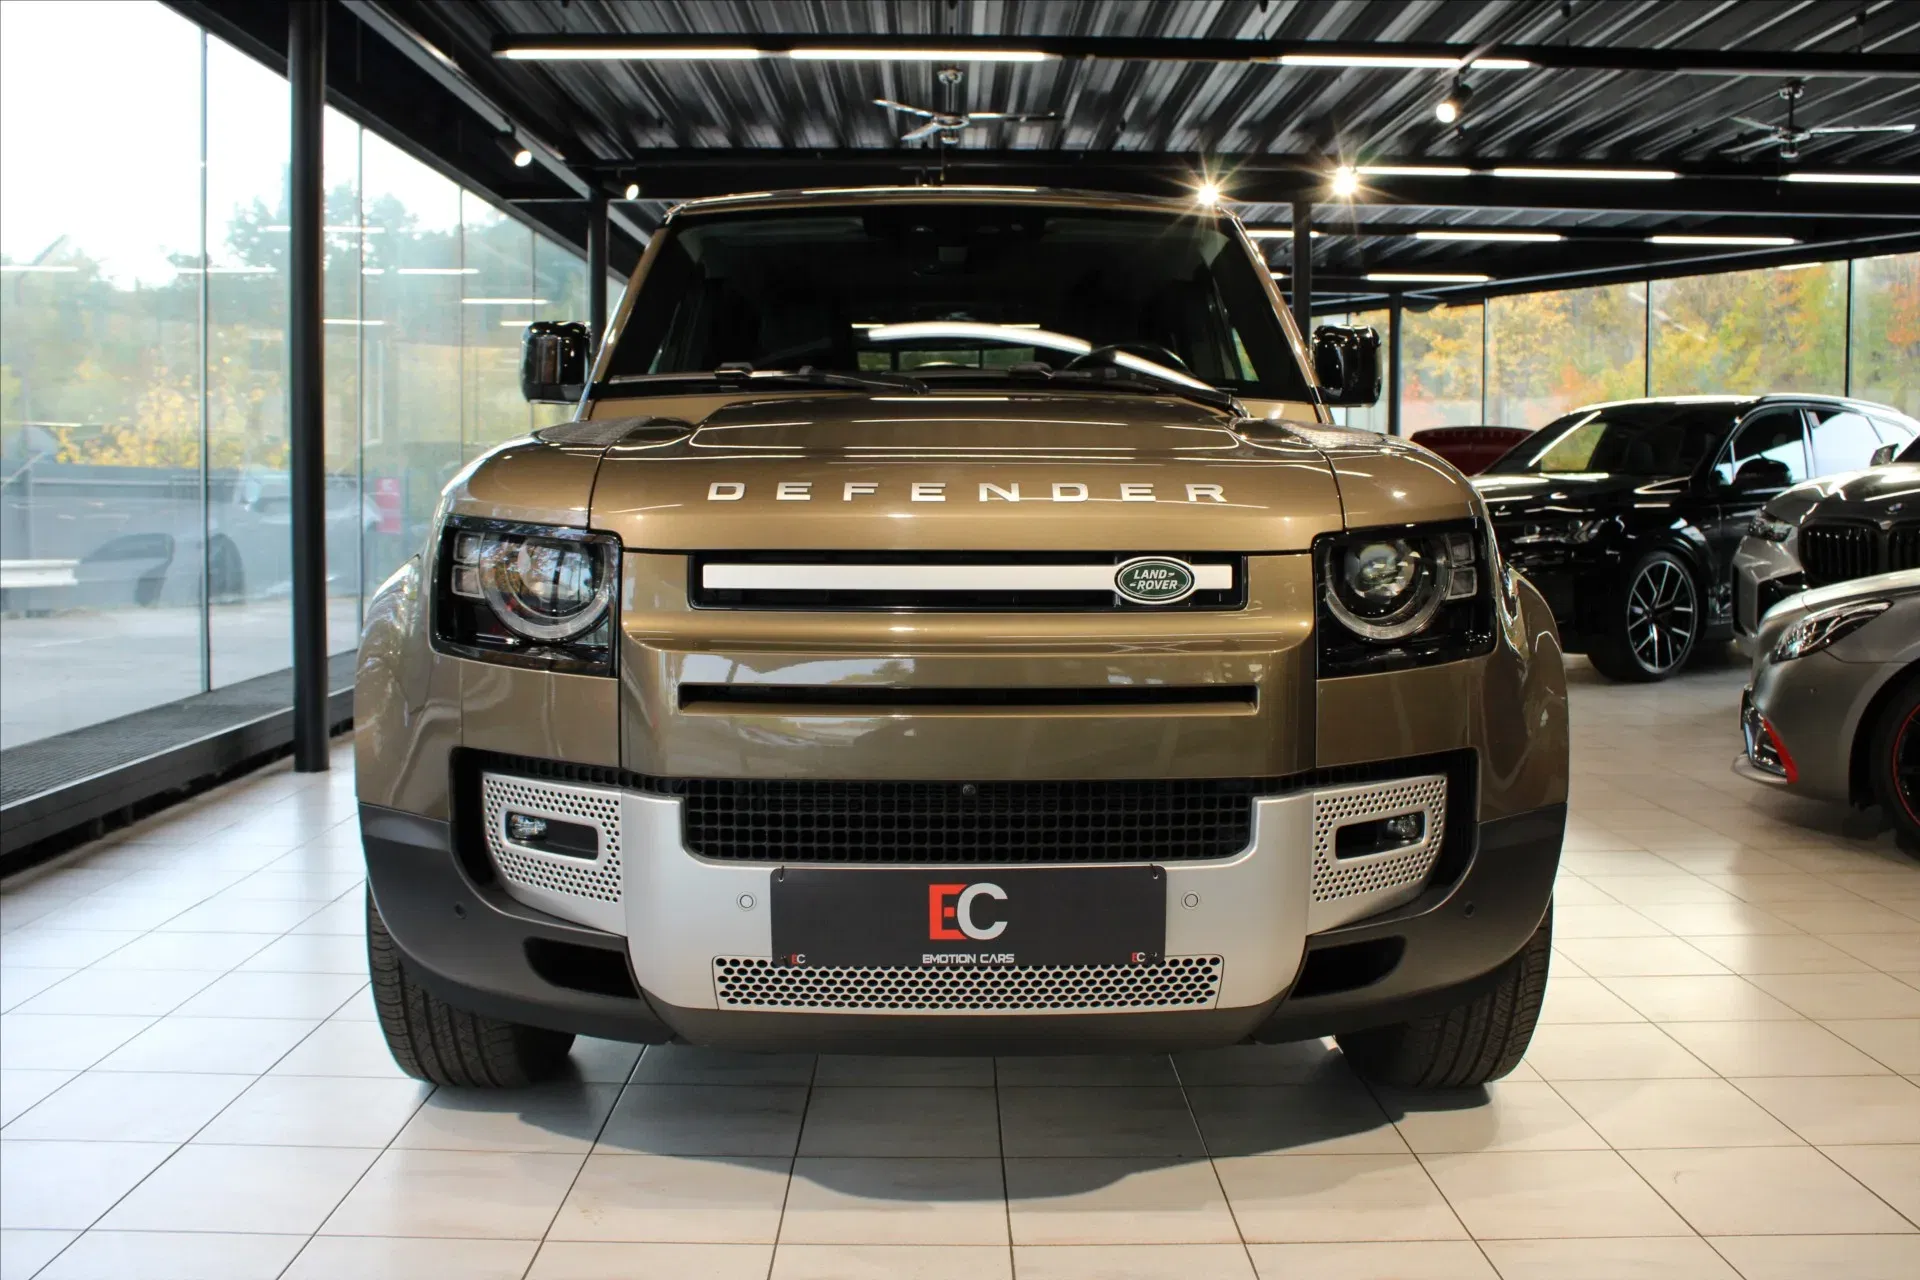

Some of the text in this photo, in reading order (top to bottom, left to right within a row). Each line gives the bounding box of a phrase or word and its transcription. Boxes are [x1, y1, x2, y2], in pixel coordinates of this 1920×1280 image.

[707, 481, 1227, 503] DEFENDER
[928, 882, 1008, 940] EC
[922, 953, 1015, 964] EMOTION CARS
